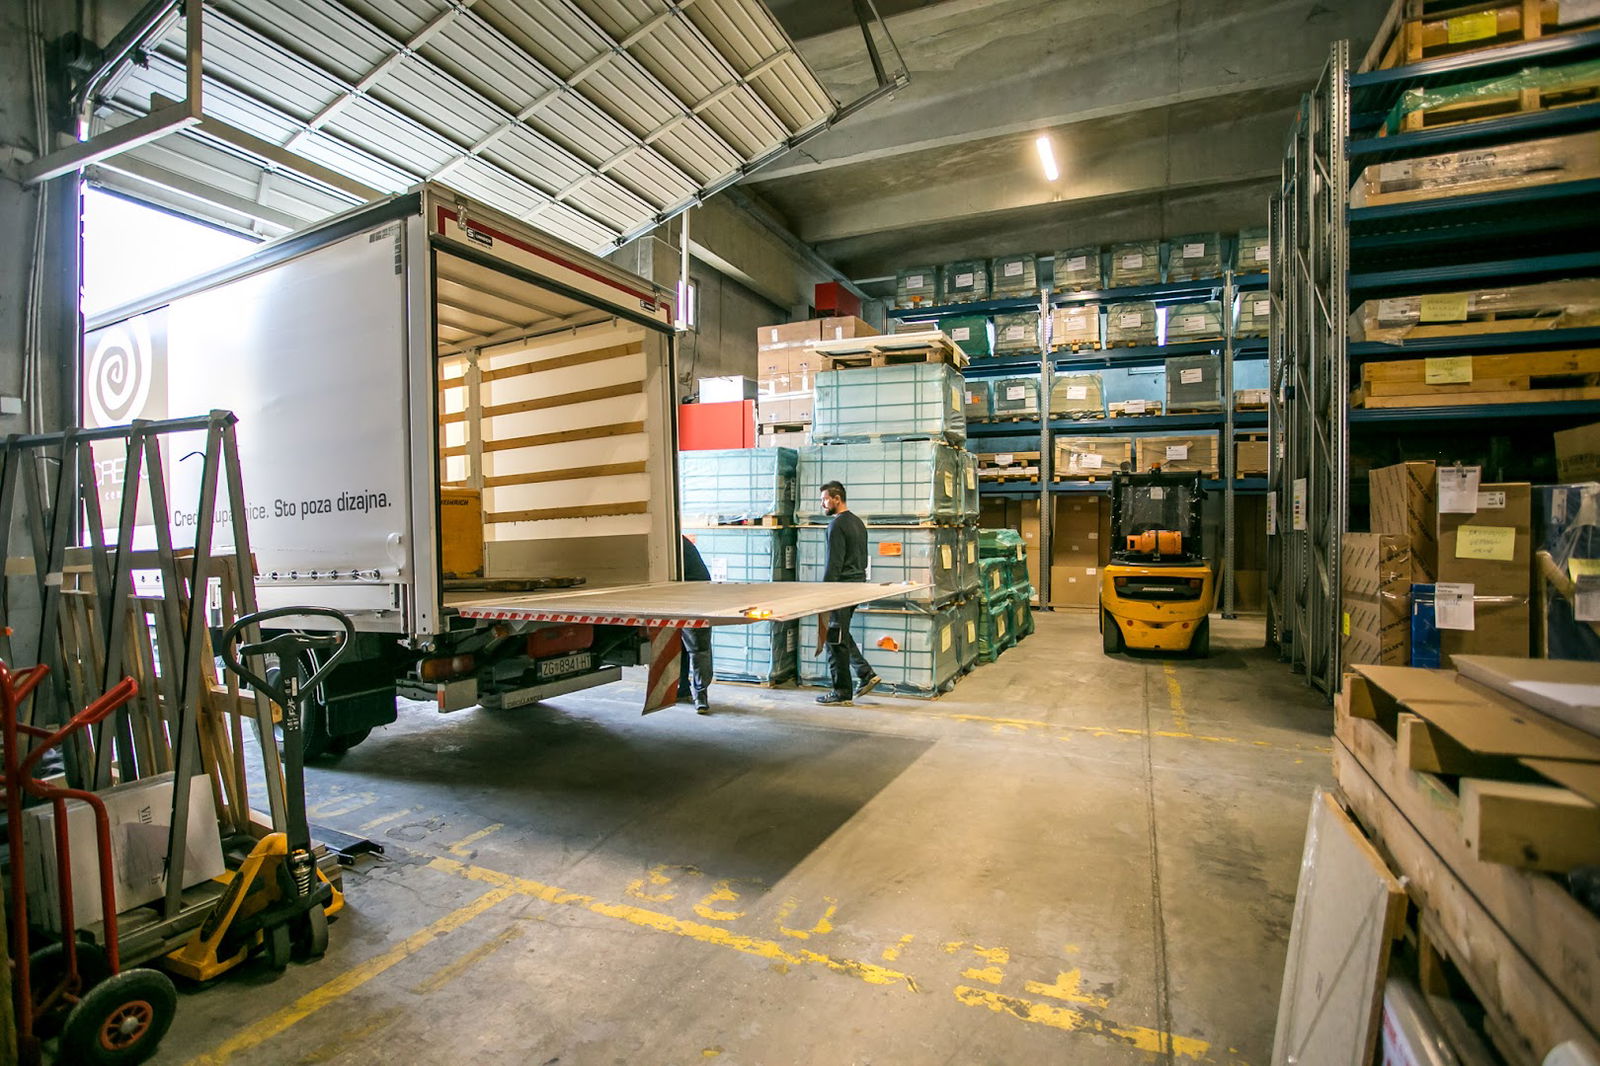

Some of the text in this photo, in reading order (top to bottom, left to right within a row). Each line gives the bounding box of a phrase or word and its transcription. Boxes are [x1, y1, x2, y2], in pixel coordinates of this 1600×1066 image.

[274, 498, 296, 518] Sto
[301, 498, 332, 520] poza
[336, 489, 392, 514] dizajna.
